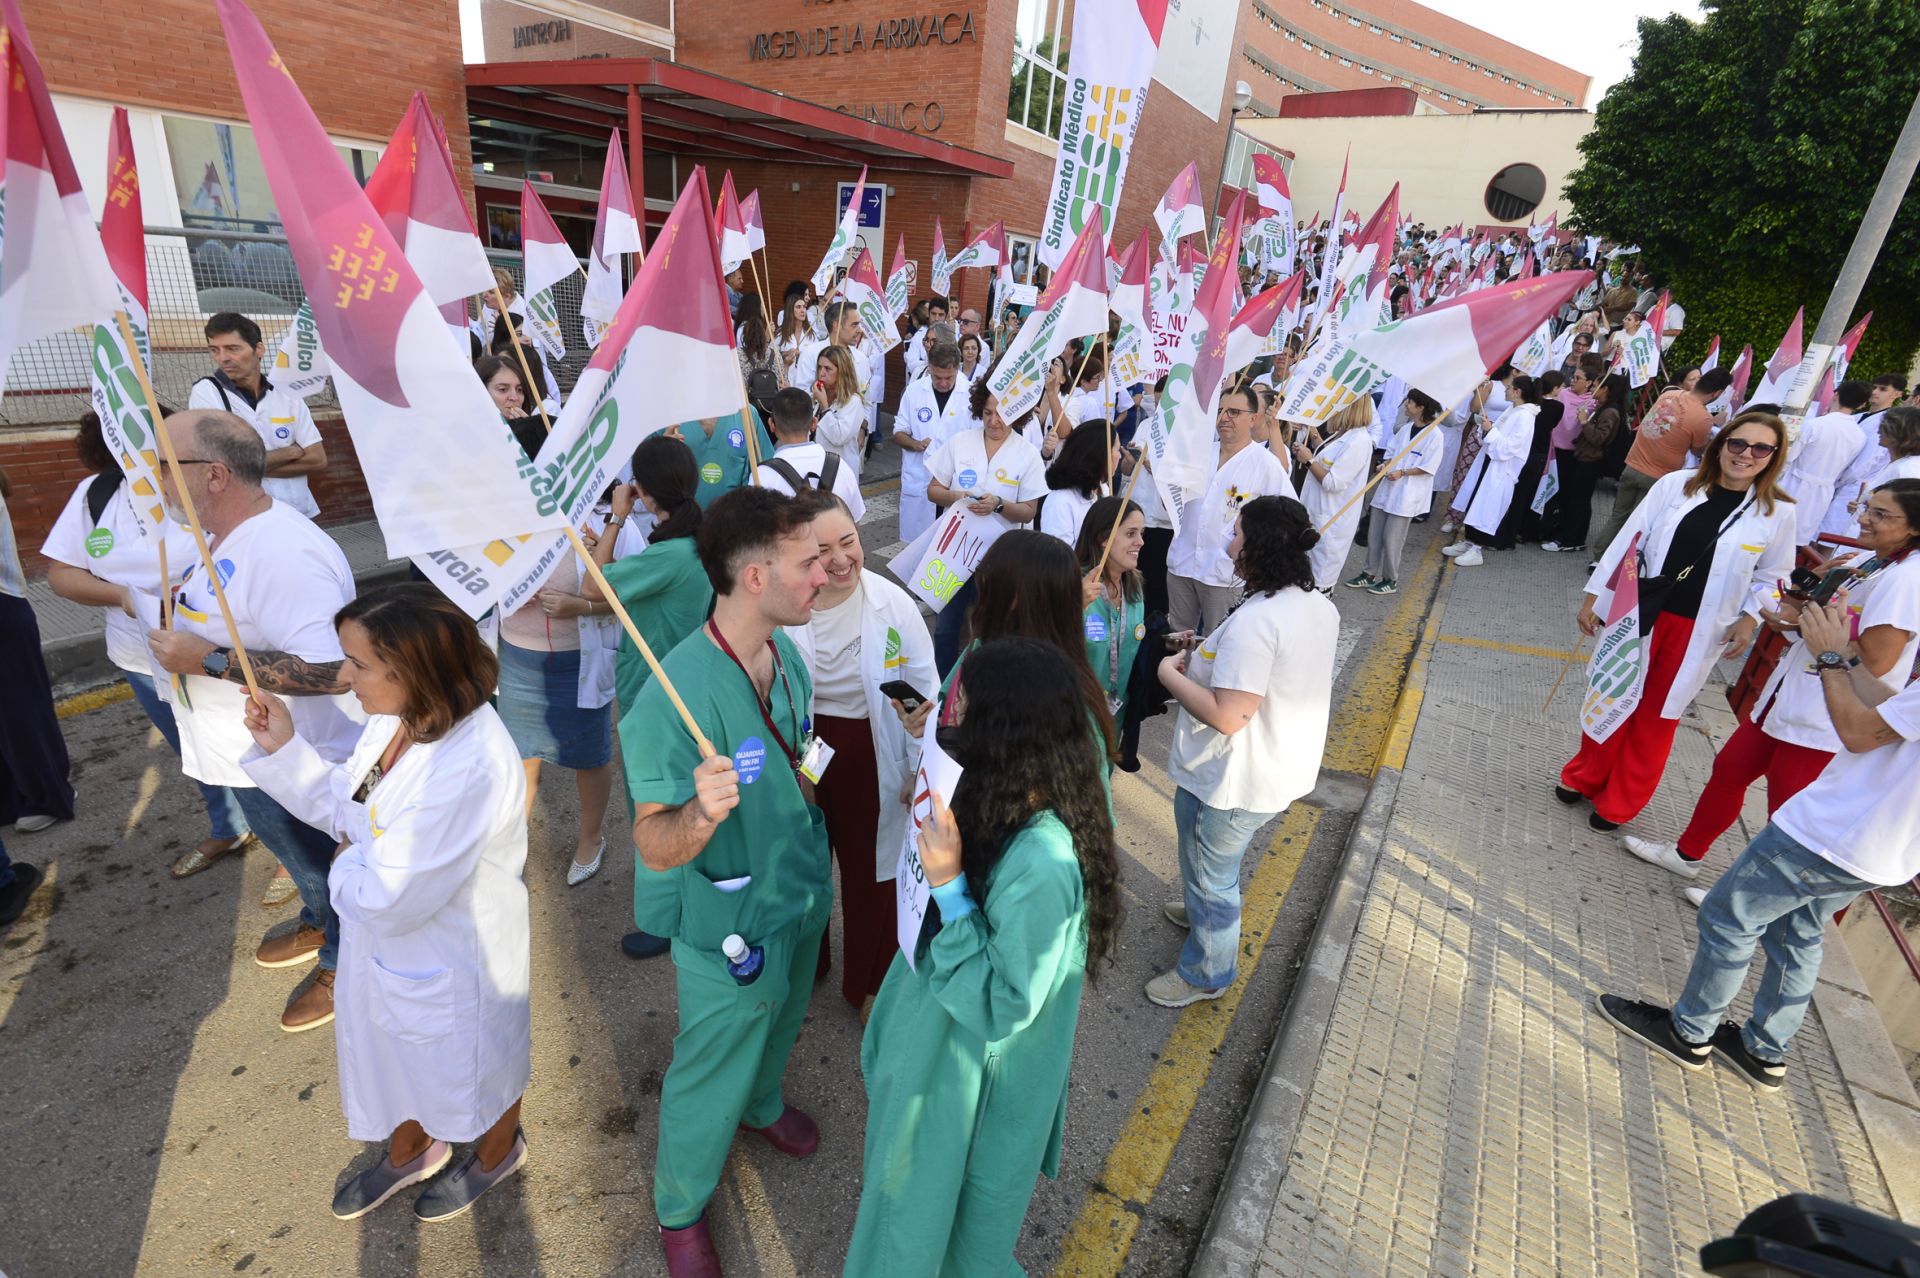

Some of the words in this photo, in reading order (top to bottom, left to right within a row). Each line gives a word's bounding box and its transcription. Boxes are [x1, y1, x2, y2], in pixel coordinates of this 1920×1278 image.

[747, 30, 811, 61] VIRGEN
[815, 25, 839, 56] DE
[842, 23, 865, 53] LA
[871, 10, 977, 49] ARRIXACA
[1045, 159, 1075, 250] Sindicato
[1063, 77, 1087, 154] Médico
[533, 321, 542, 332] de
[541, 330, 562, 355] Murcia
[1313, 361, 1327, 378] de
[1286, 377, 1319, 416] Murcia
[736, 748, 765, 759] GUARDIAS
[740, 758, 751, 767] SIN
[751, 757, 760, 766] FIN
